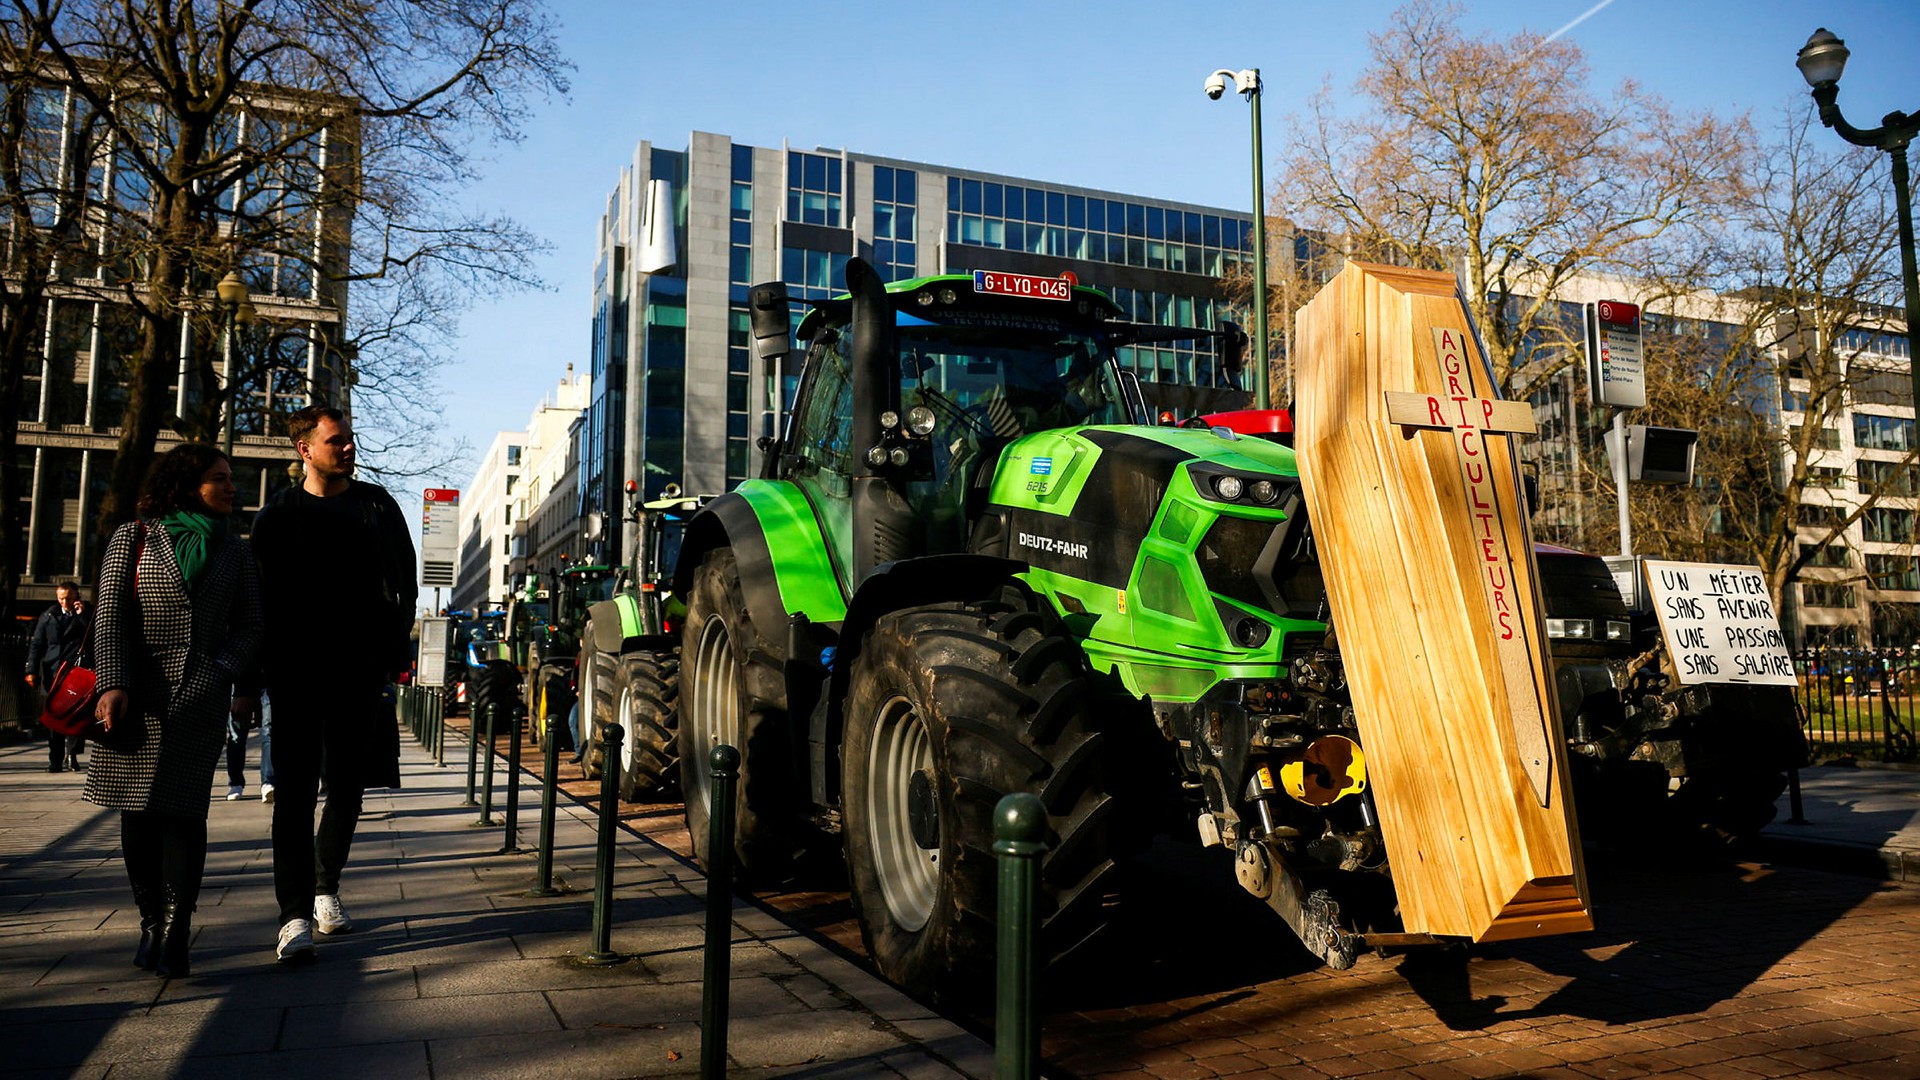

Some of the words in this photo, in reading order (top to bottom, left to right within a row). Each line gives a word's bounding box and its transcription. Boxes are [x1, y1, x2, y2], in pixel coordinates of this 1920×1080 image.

[1603, 306, 1609, 316] B
[1026, 481, 1048, 493] 6215
[1442, 330, 1513, 640] AGRICULTEURS
[1019, 532, 1088, 559] DEUTZ-FAHR
[1661, 570, 1690, 592] UN
[1666, 597, 1705, 620] SANS
[1717, 598, 1774, 620] AVENIR
[1676, 627, 1709, 649] UNE
[1725, 626, 1786, 649] PASSION
[1683, 653, 1719, 675] SANS
[1734, 652, 1794, 677] SALAIRE
